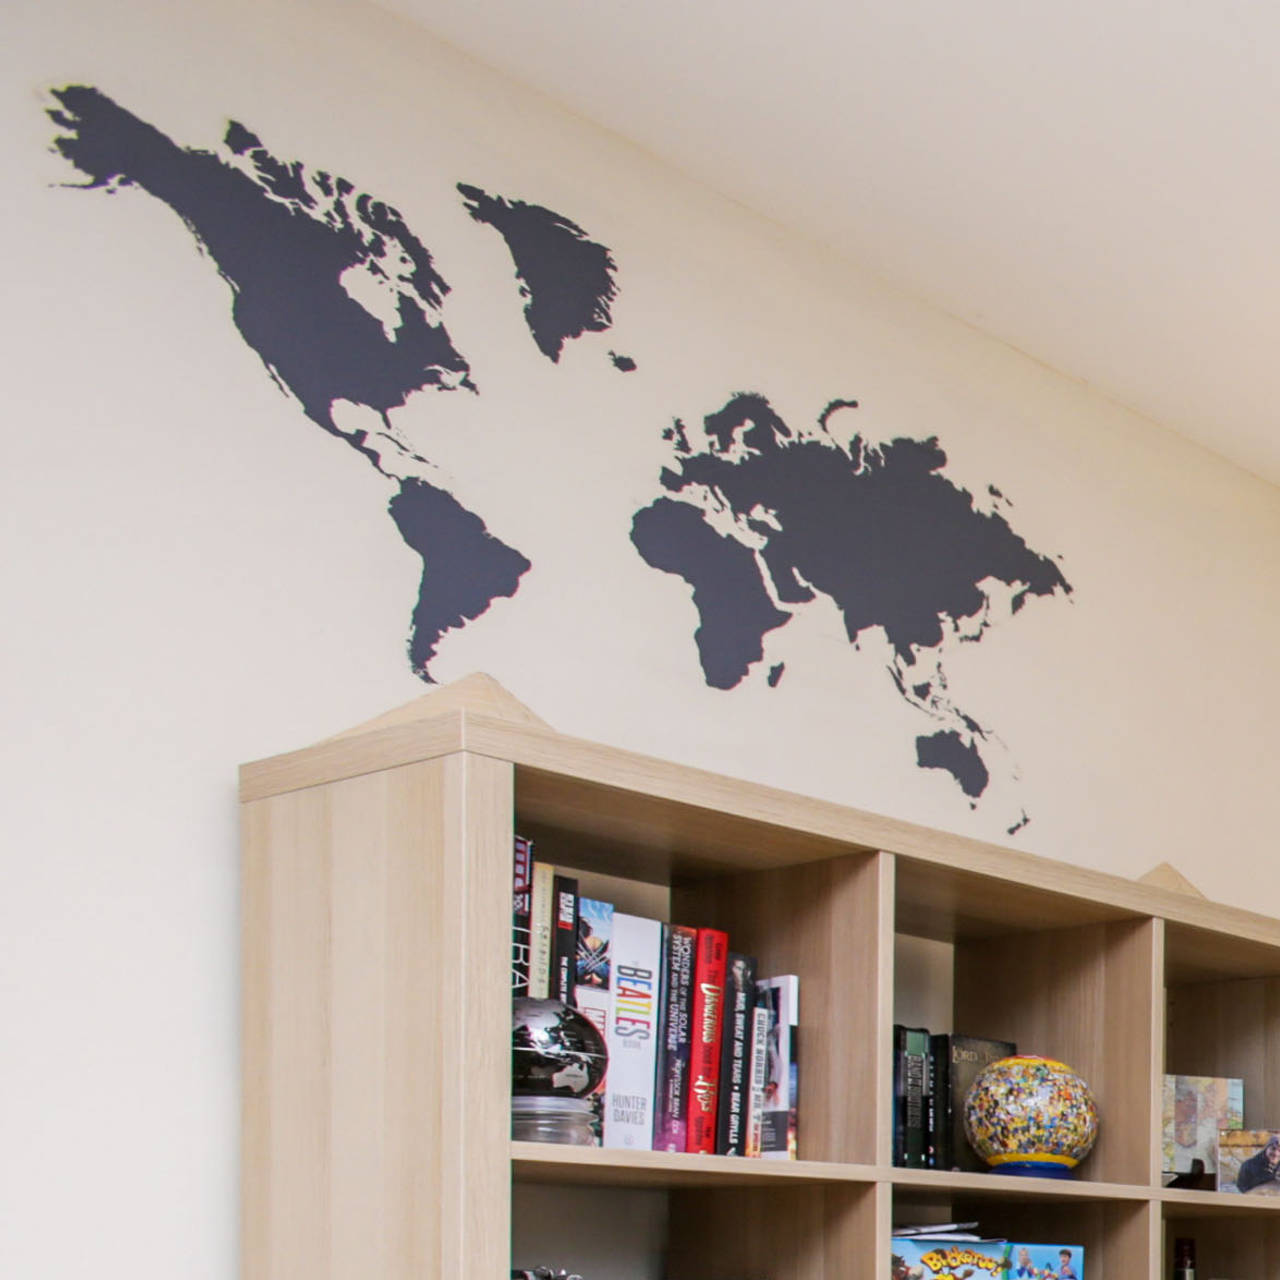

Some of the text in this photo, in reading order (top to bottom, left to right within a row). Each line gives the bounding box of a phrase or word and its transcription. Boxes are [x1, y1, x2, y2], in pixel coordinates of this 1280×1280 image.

[672, 934, 682, 971] SYSTEM
[680, 936, 692, 986] WONDERS
[615, 964, 652, 1040] BEATLES
[667, 1003, 679, 1051] UNIVERSE
[677, 1012, 688, 1043] SOLAR
[734, 1013, 745, 1040] SWEAT
[733, 1040, 744, 1058] AND
[754, 1012, 767, 1086] CHUCK NORRIS
[732, 1059, 742, 1084] TEARS
[612, 1093, 647, 1112] HUNTER
[613, 1109, 646, 1126] DAVIES
[730, 1092, 741, 1113] BEAR
[728, 1114, 740, 1144] GRYLLS
